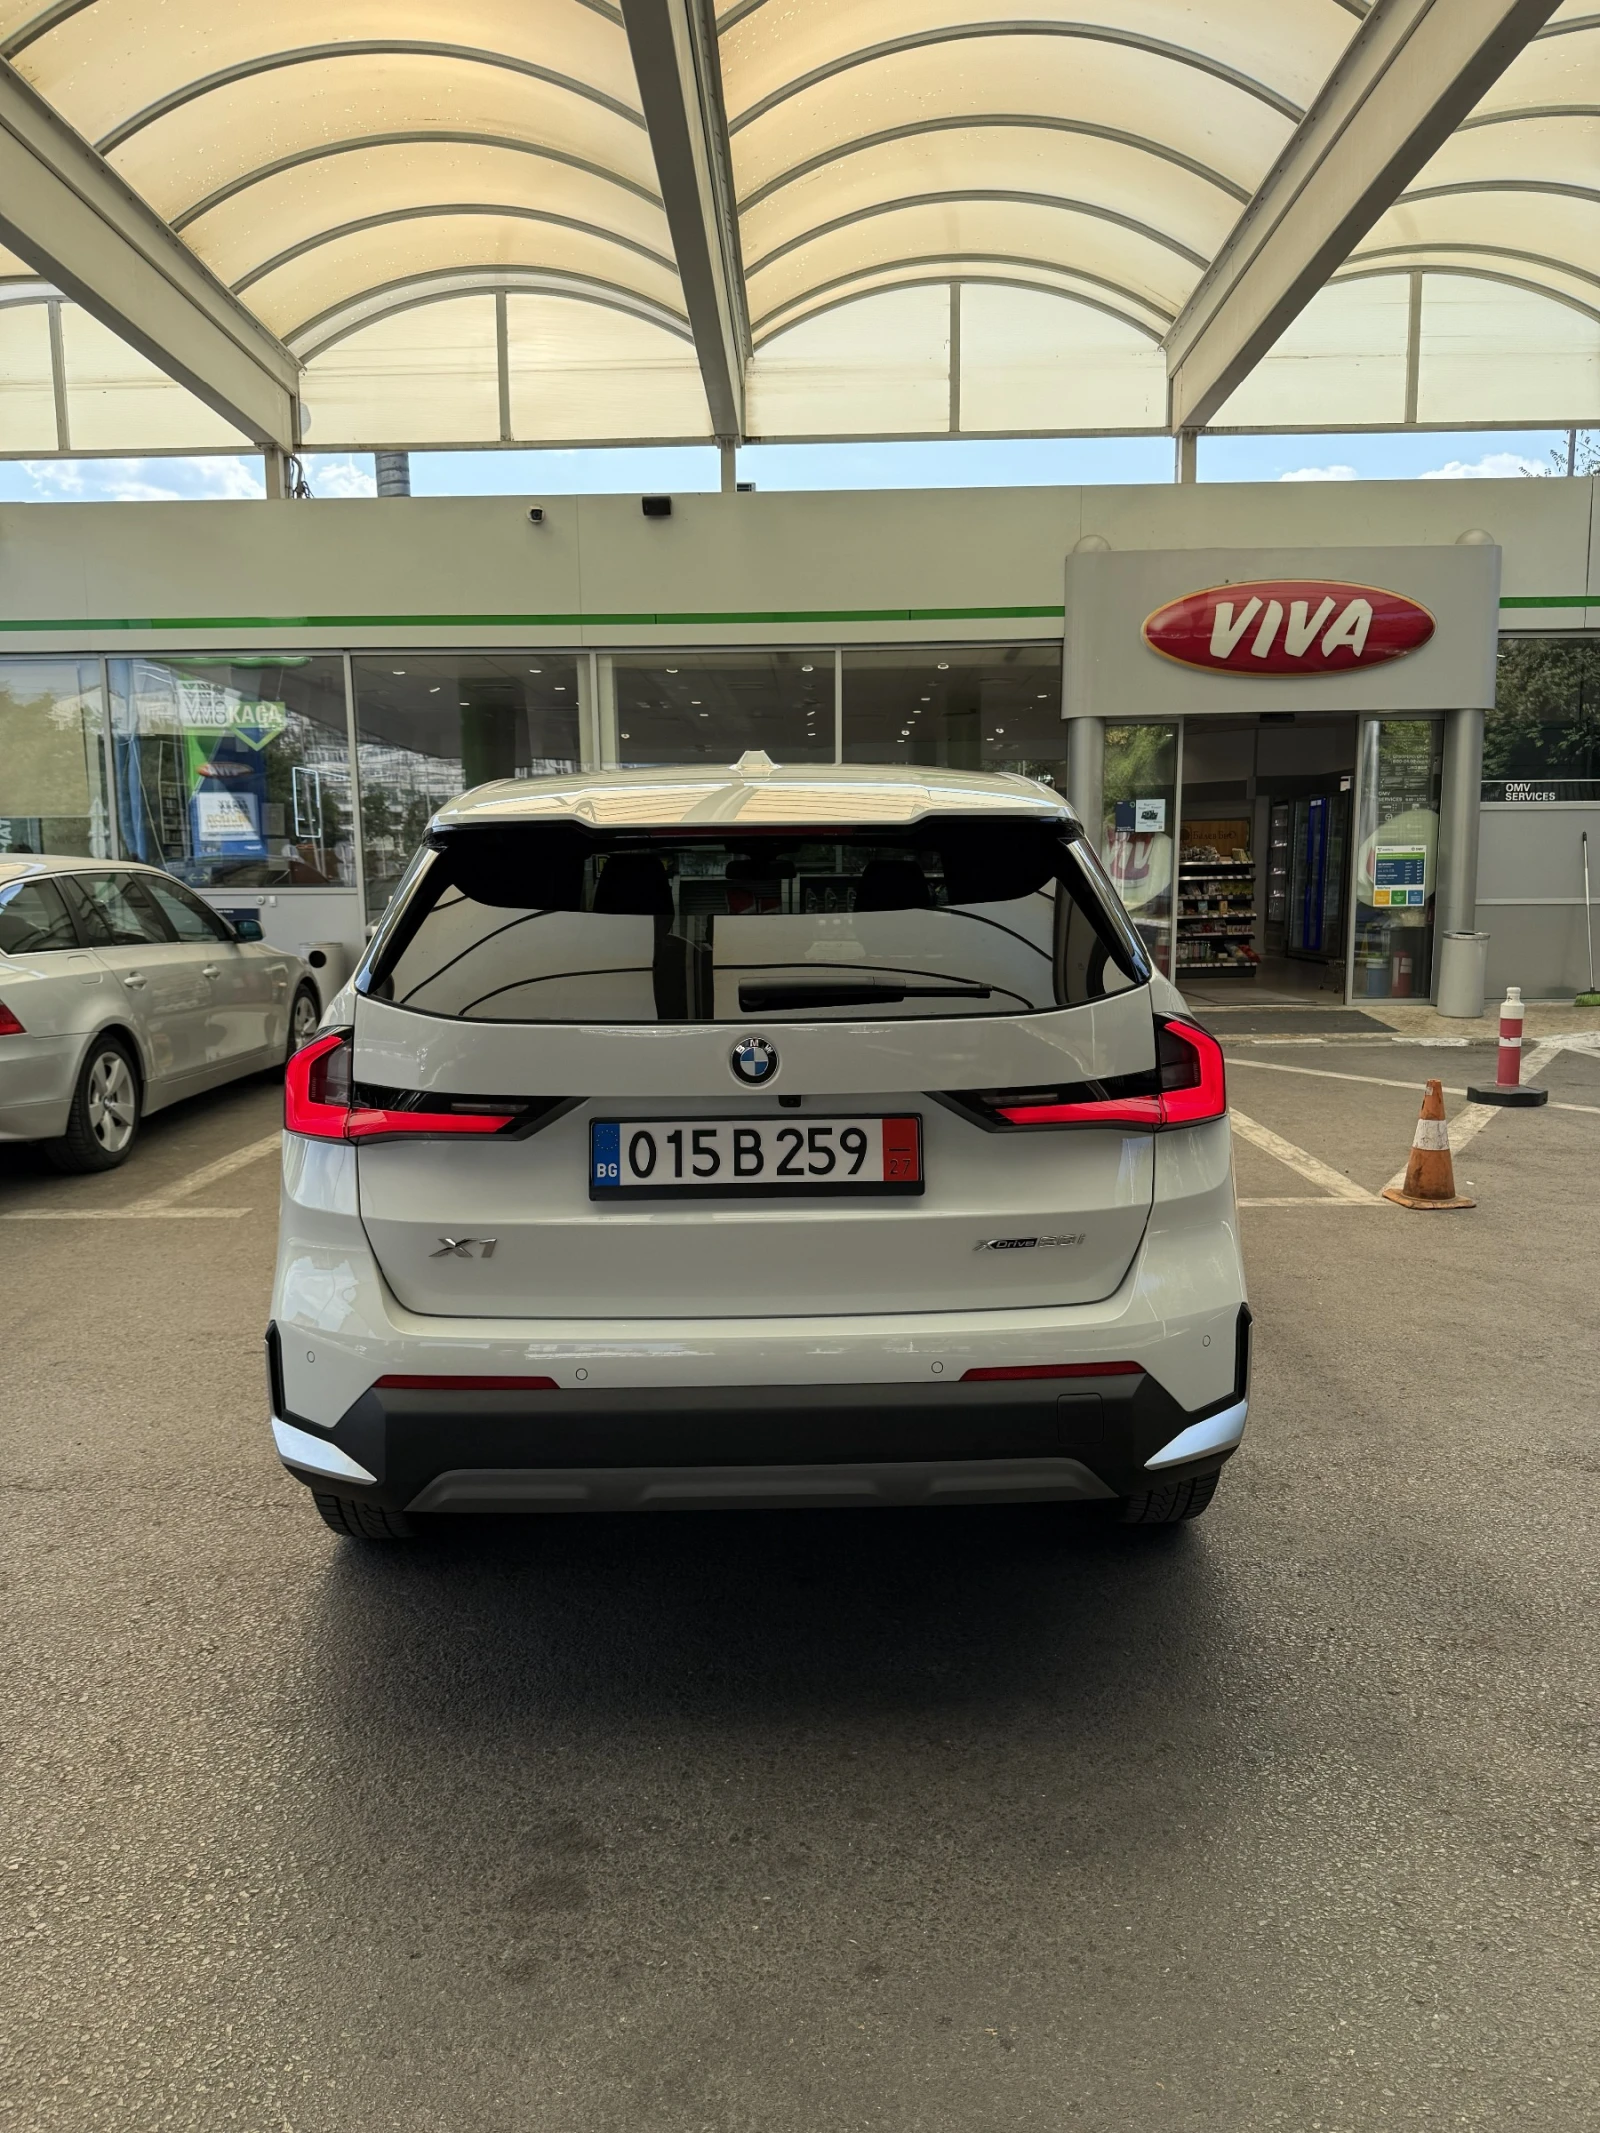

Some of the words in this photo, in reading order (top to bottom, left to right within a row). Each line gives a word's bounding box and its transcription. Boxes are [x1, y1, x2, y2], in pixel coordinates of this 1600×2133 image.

[1209, 596, 1373, 659] VIVA
[1505, 783, 1531, 792] OMV
[1505, 792, 1556, 801] SERVICES
[736, 1039, 774, 1054] BMW
[597, 1163, 617, 1178] BG
[889, 1158, 911, 1175] 27
[428, 1238, 497, 1258] X1
